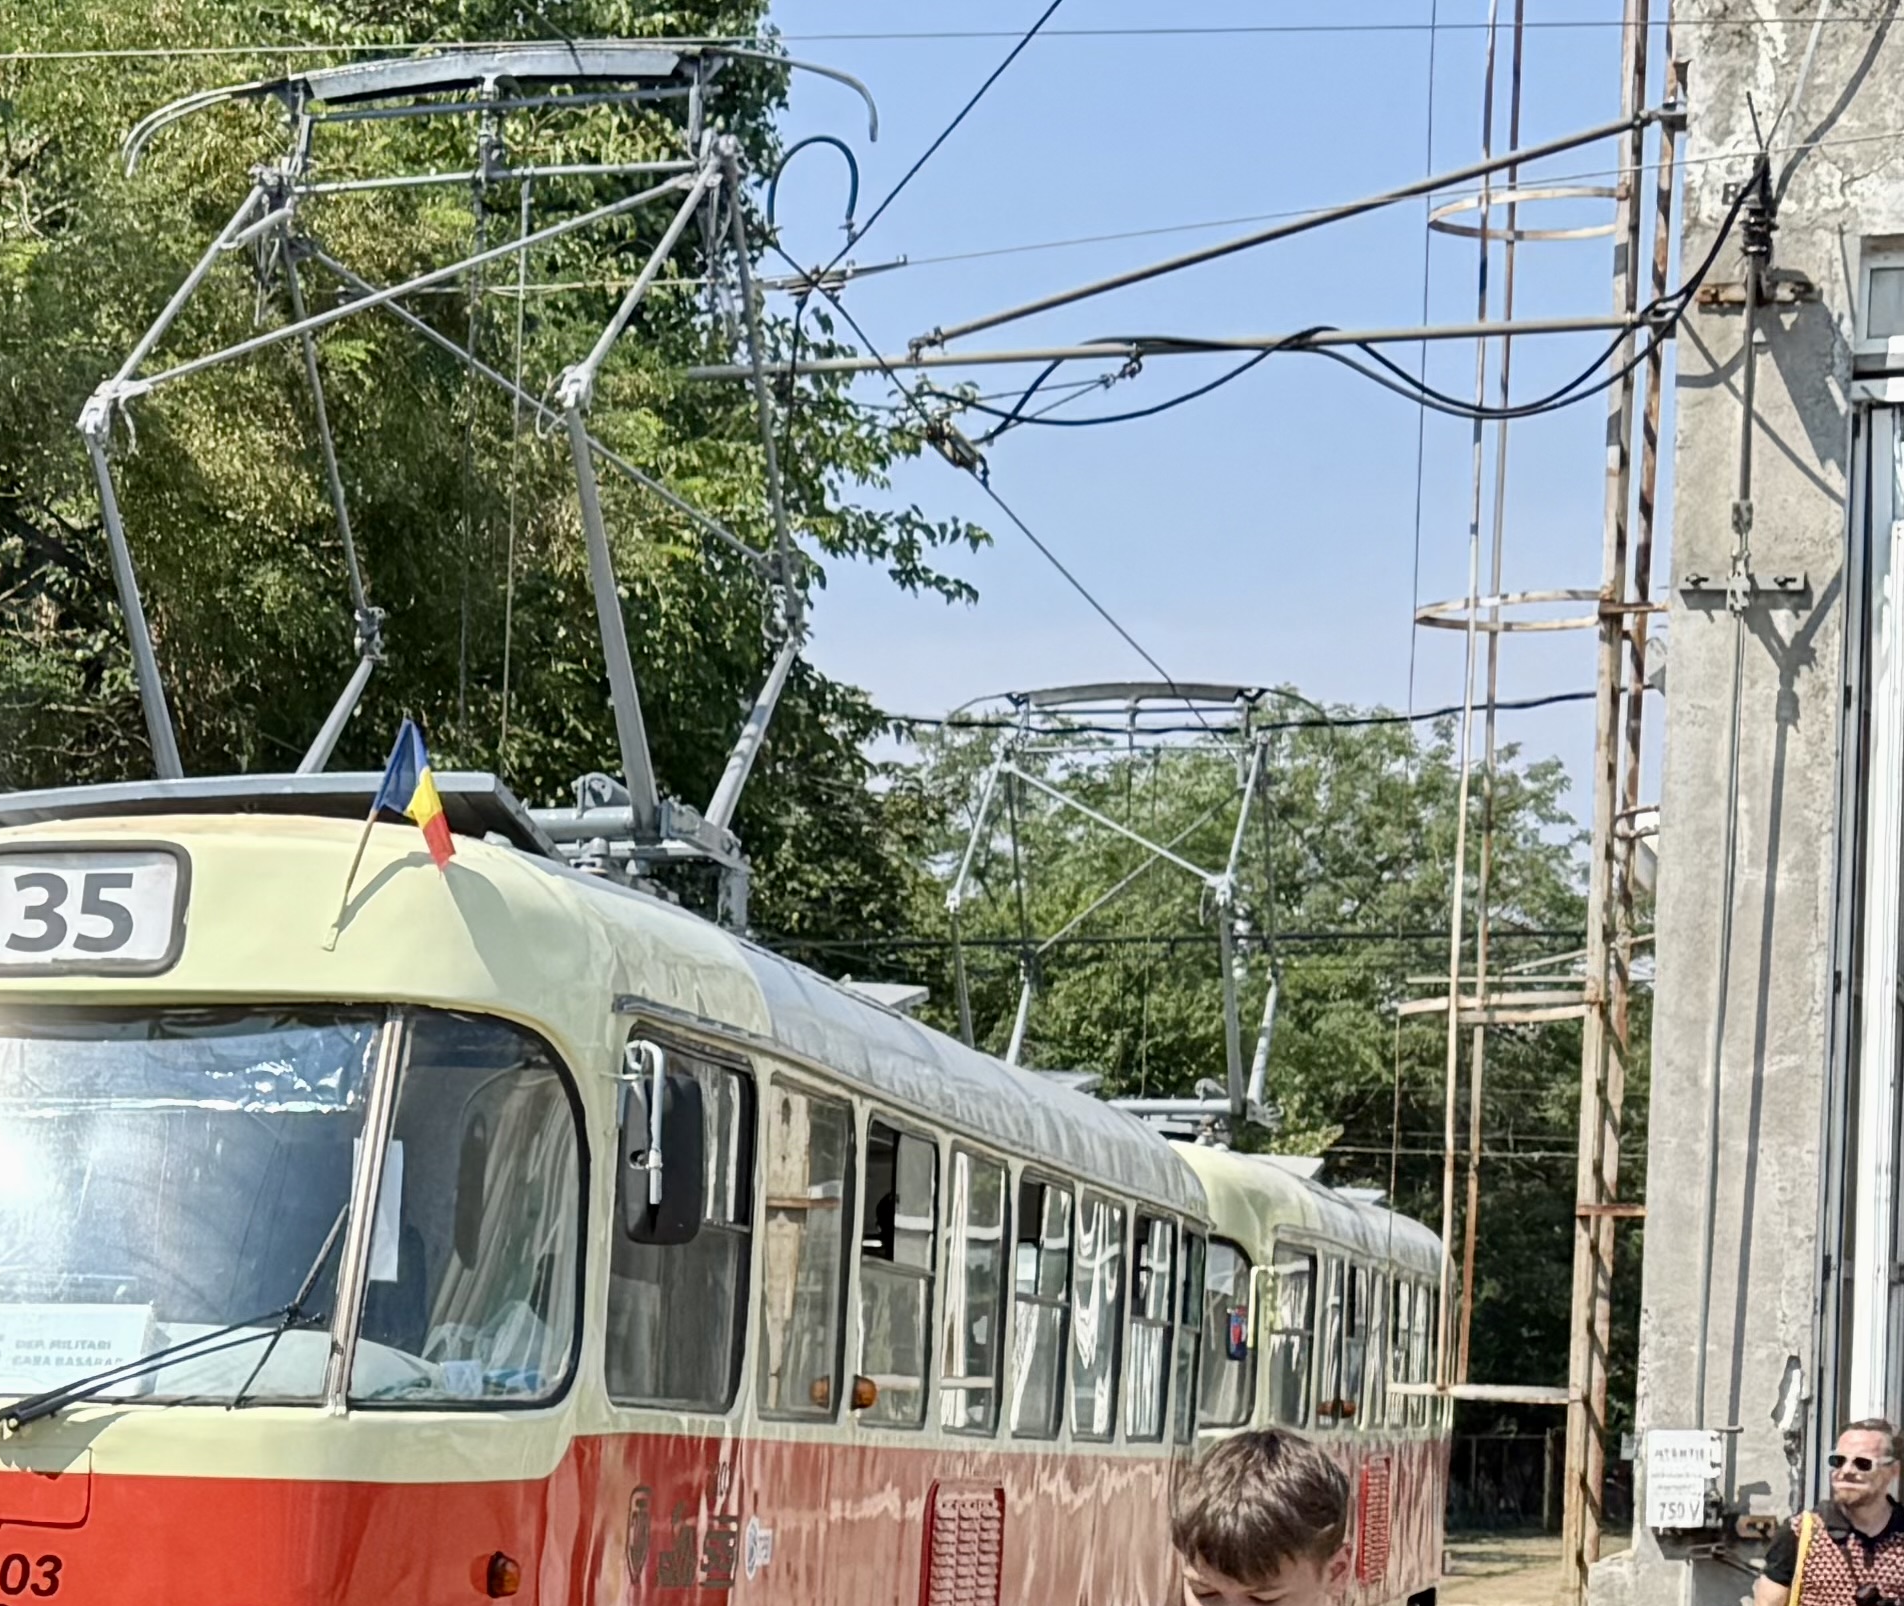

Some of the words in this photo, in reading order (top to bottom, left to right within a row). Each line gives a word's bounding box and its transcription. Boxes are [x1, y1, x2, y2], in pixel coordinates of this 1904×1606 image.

[5, 873, 133, 952] 35
[49, 1340, 112, 1350] MILITARI
[1659, 1502, 1685, 1521] 750
[1689, 1501, 1700, 1521] V
